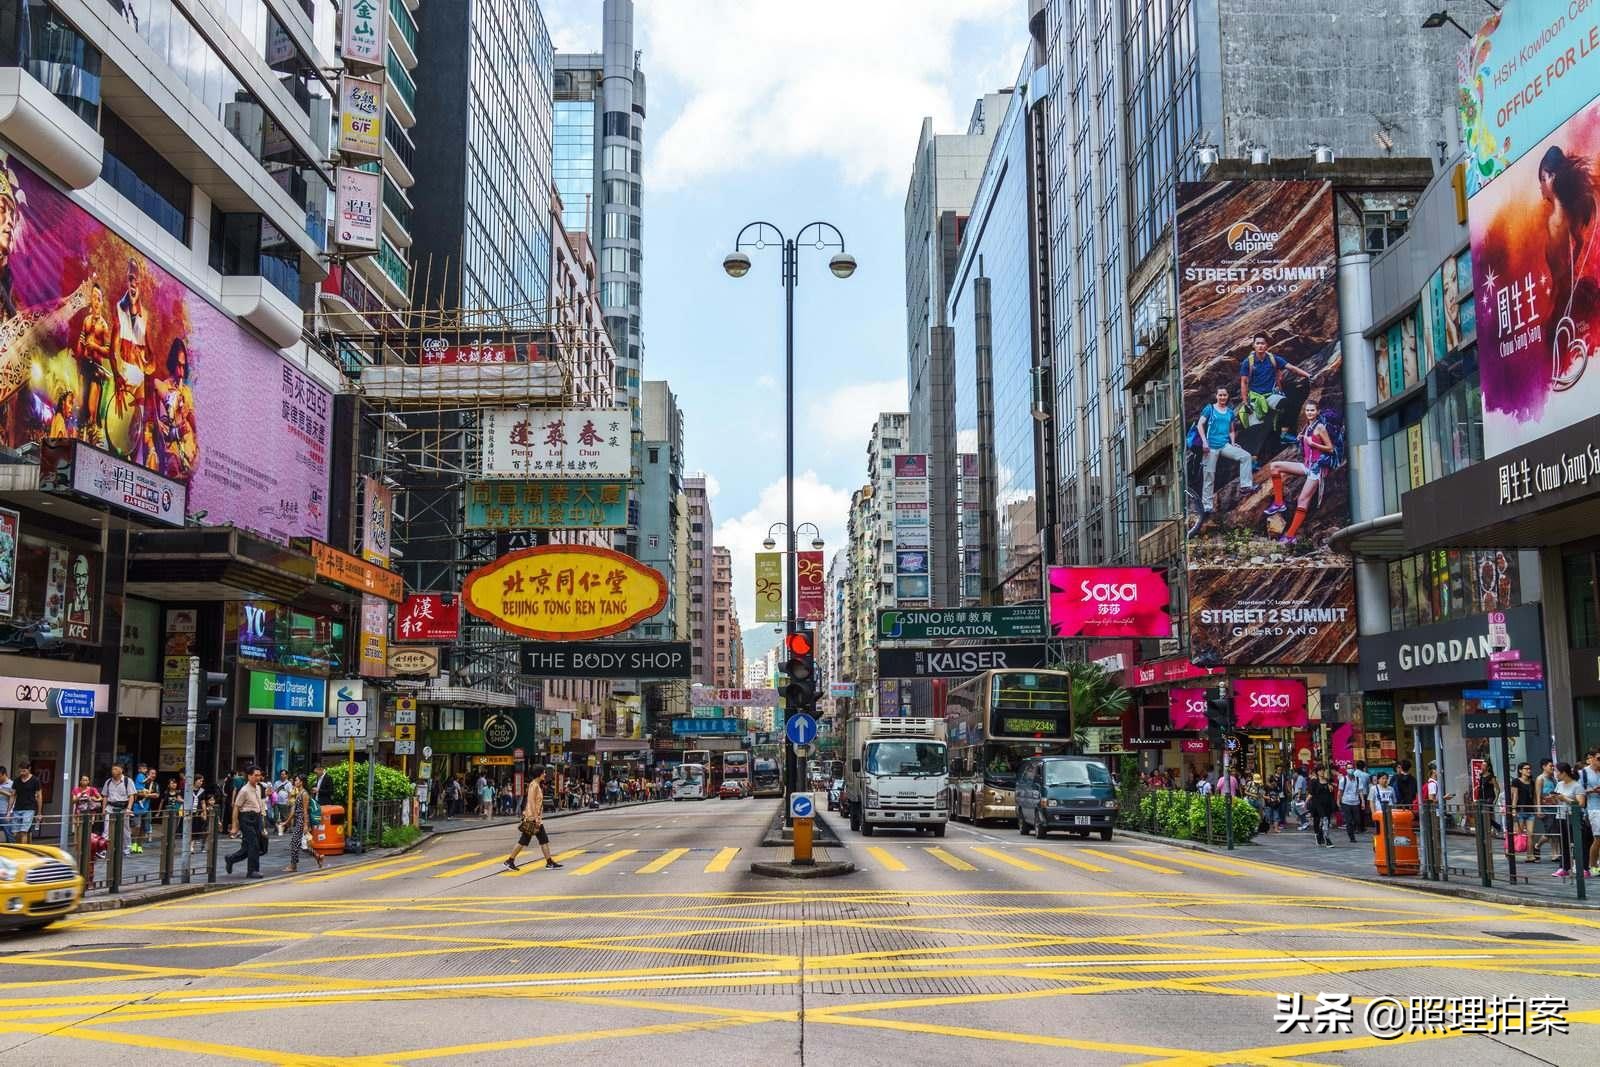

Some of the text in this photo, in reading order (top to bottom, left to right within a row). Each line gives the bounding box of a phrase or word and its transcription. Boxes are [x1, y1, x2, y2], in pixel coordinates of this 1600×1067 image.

[353, 0, 376, 36] 金山
[1492, 57, 1517, 89] HSH
[1519, 16, 1566, 63] Kowloon
[1496, 75, 1543, 128] OFFICE
[1545, 47, 1576, 87] FOR
[352, 121, 371, 134] 6/F
[1246, 230, 1279, 241] Lowe
[1235, 241, 1274, 253] alpine
[1185, 266, 1328, 281] STREET 2 SUMMIT
[1215, 285, 1299, 294] GIORDANO
[1497, 272, 1540, 338] 周生生
[282, 364, 327, 421] 馬來西亞
[510, 419, 604, 448] 蓬萊春
[511, 449, 533, 458] Peng
[579, 449, 600, 457] Chun
[1499, 457, 1533, 505] 周生生
[1535, 462, 1560, 493] Chow
[1562, 453, 1588, 485] Sang
[798, 559, 824, 585] 25
[503, 568, 628, 597] 北京同仁堂
[756, 577, 782, 603] 25
[1081, 580, 1137, 601] Sasa
[401, 596, 434, 638] 漢和
[503, 600, 628, 618] BEIJING TONG REN TANG
[906, 611, 993, 624] SINO 尚華教育
[1097, 603, 1121, 615] 莎莎
[1201, 607, 1348, 623] STREET 2 SUMMIT
[67, 624, 89, 639] KFC
[1232, 627, 1318, 637] GIORDANO
[528, 652, 682, 669] THE BODY SHOP
[927, 650, 1007, 673] KAISER
[16, 684, 48, 702] G200
[263, 678, 308, 694] Standard Chartered
[1249, 692, 1290, 708] Sasa
